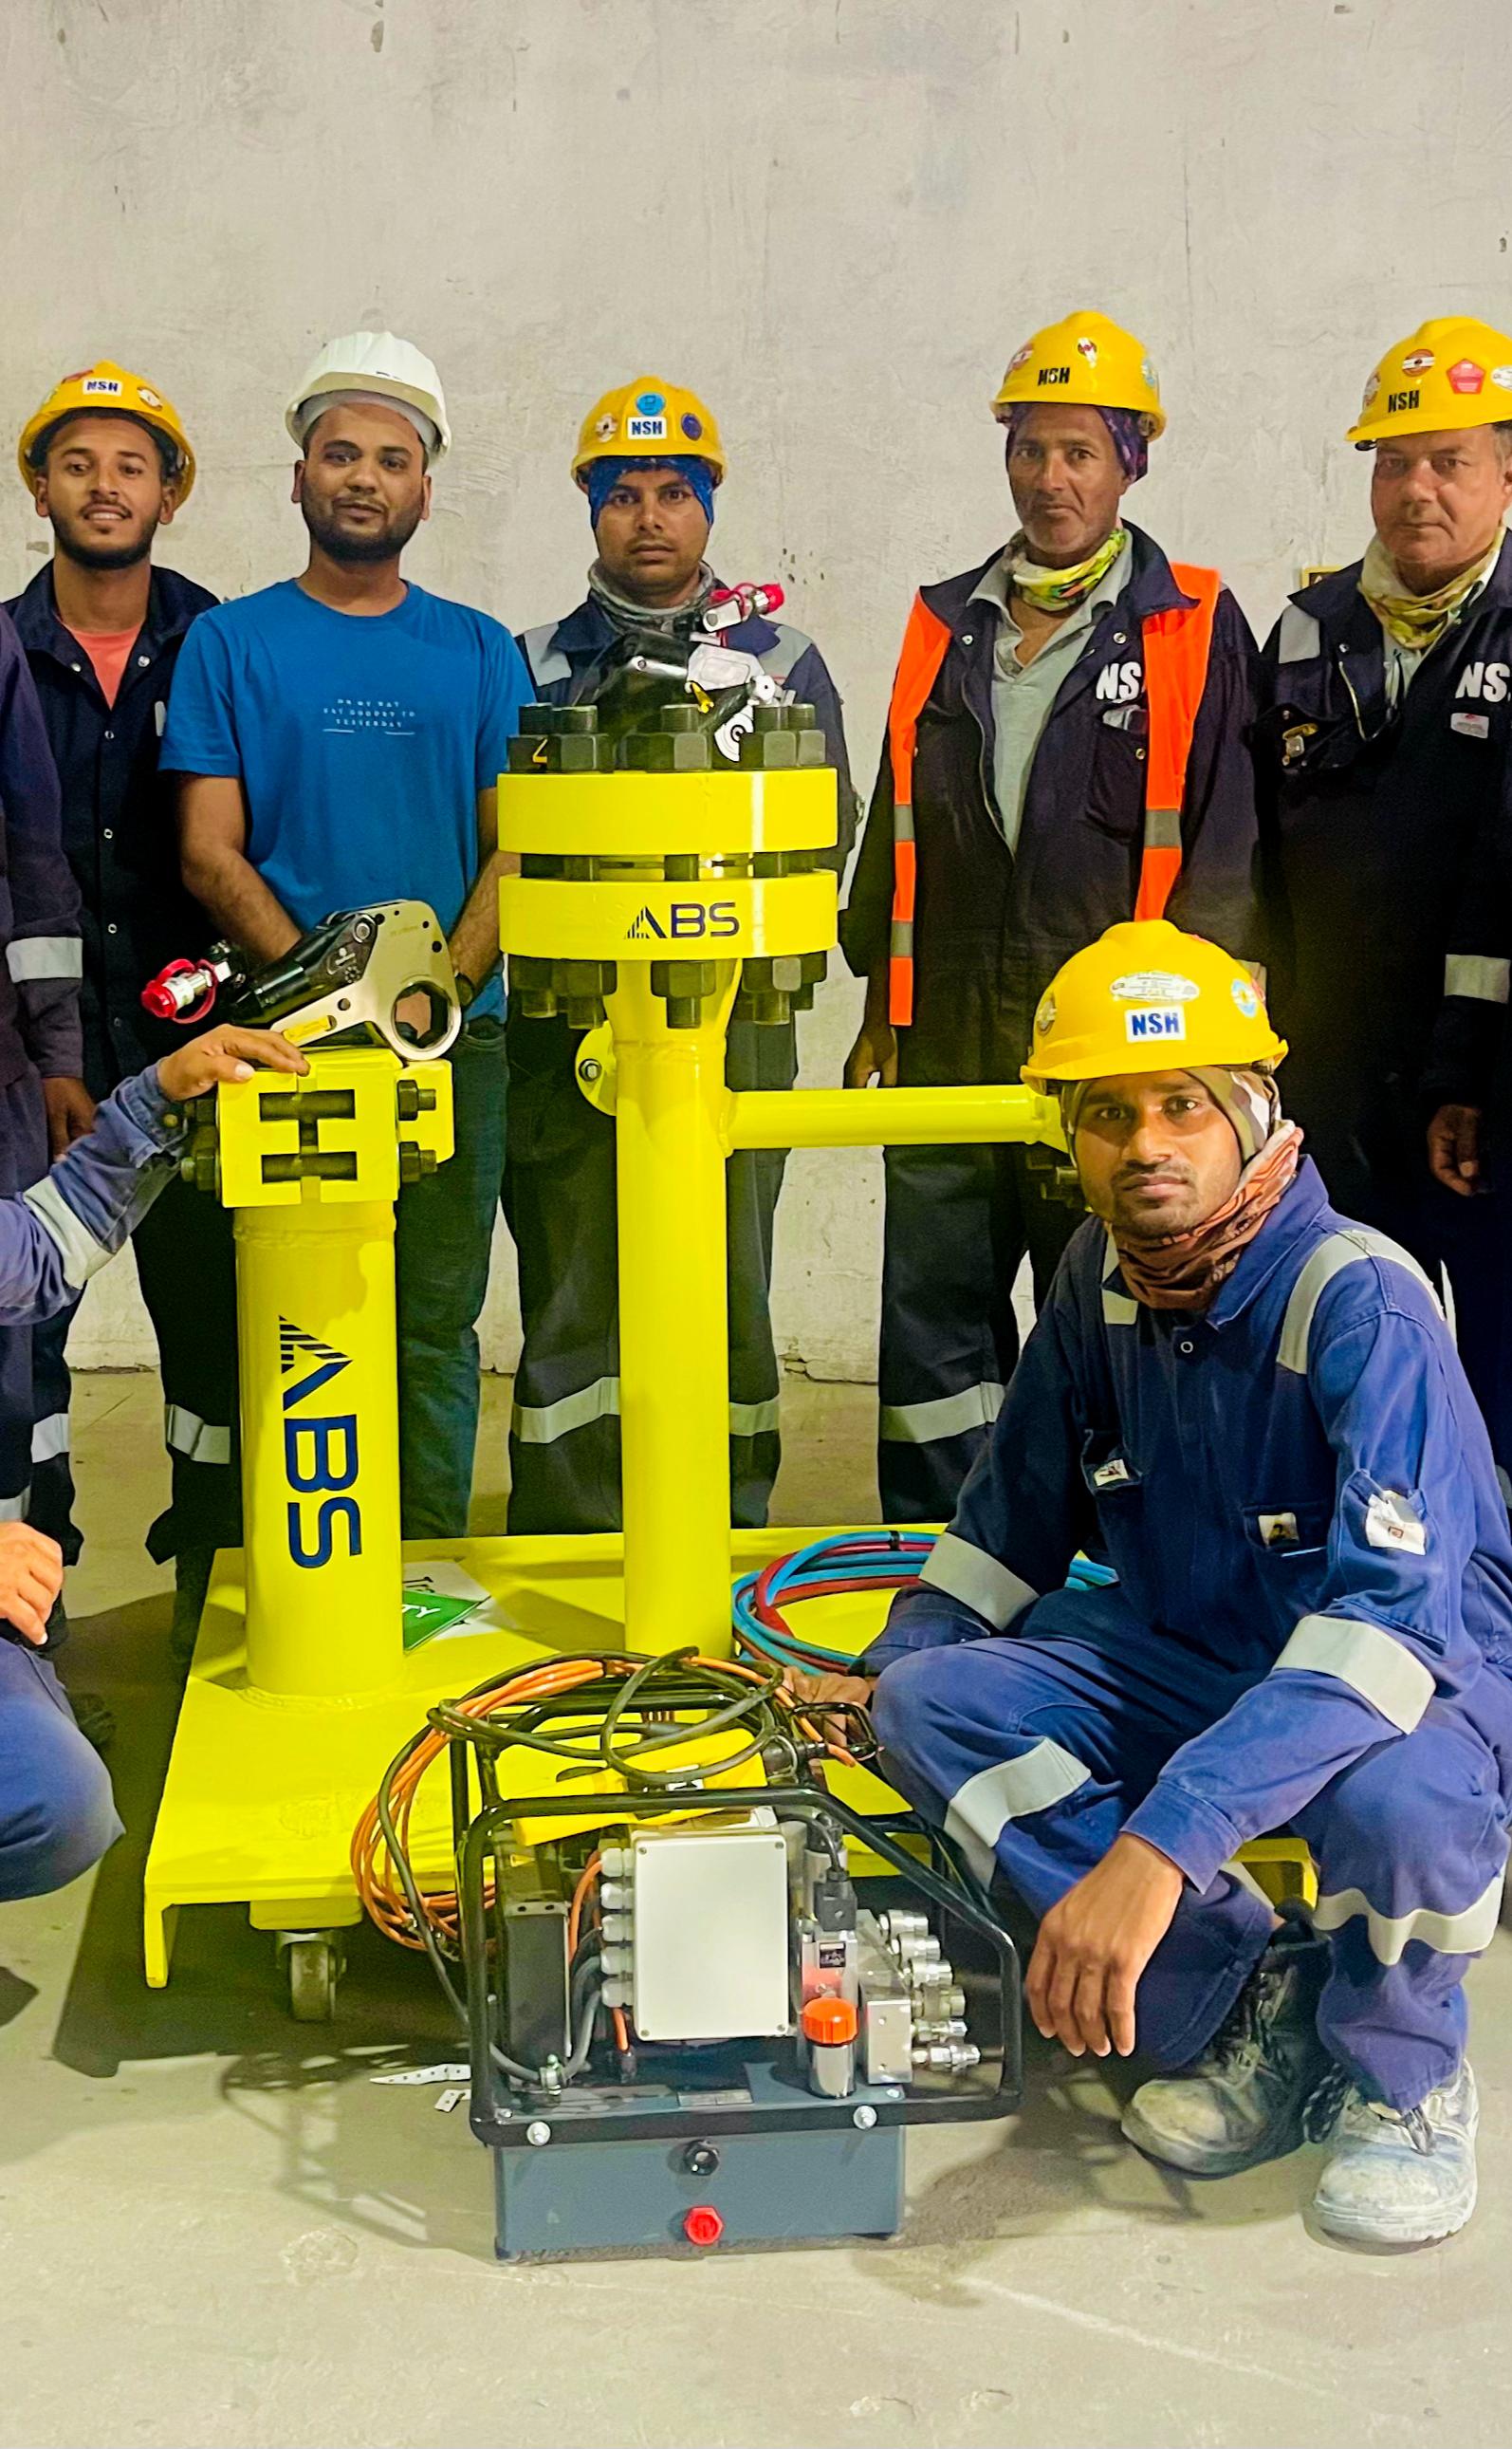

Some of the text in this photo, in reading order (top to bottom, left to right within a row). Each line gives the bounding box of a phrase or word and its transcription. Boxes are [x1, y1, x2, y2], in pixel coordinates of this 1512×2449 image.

[86, 381, 119, 392] NSH
[1038, 367, 1070, 386] NSH
[1388, 390, 1420, 413] NSH
[632, 421, 663, 436] NSH
[1096, 661, 1146, 702] NS
[1455, 661, 1512, 702] NS
[623, 901, 740, 939] ABS
[1132, 1012, 1180, 1036] NSH
[279, 1315, 362, 1569] ABS
